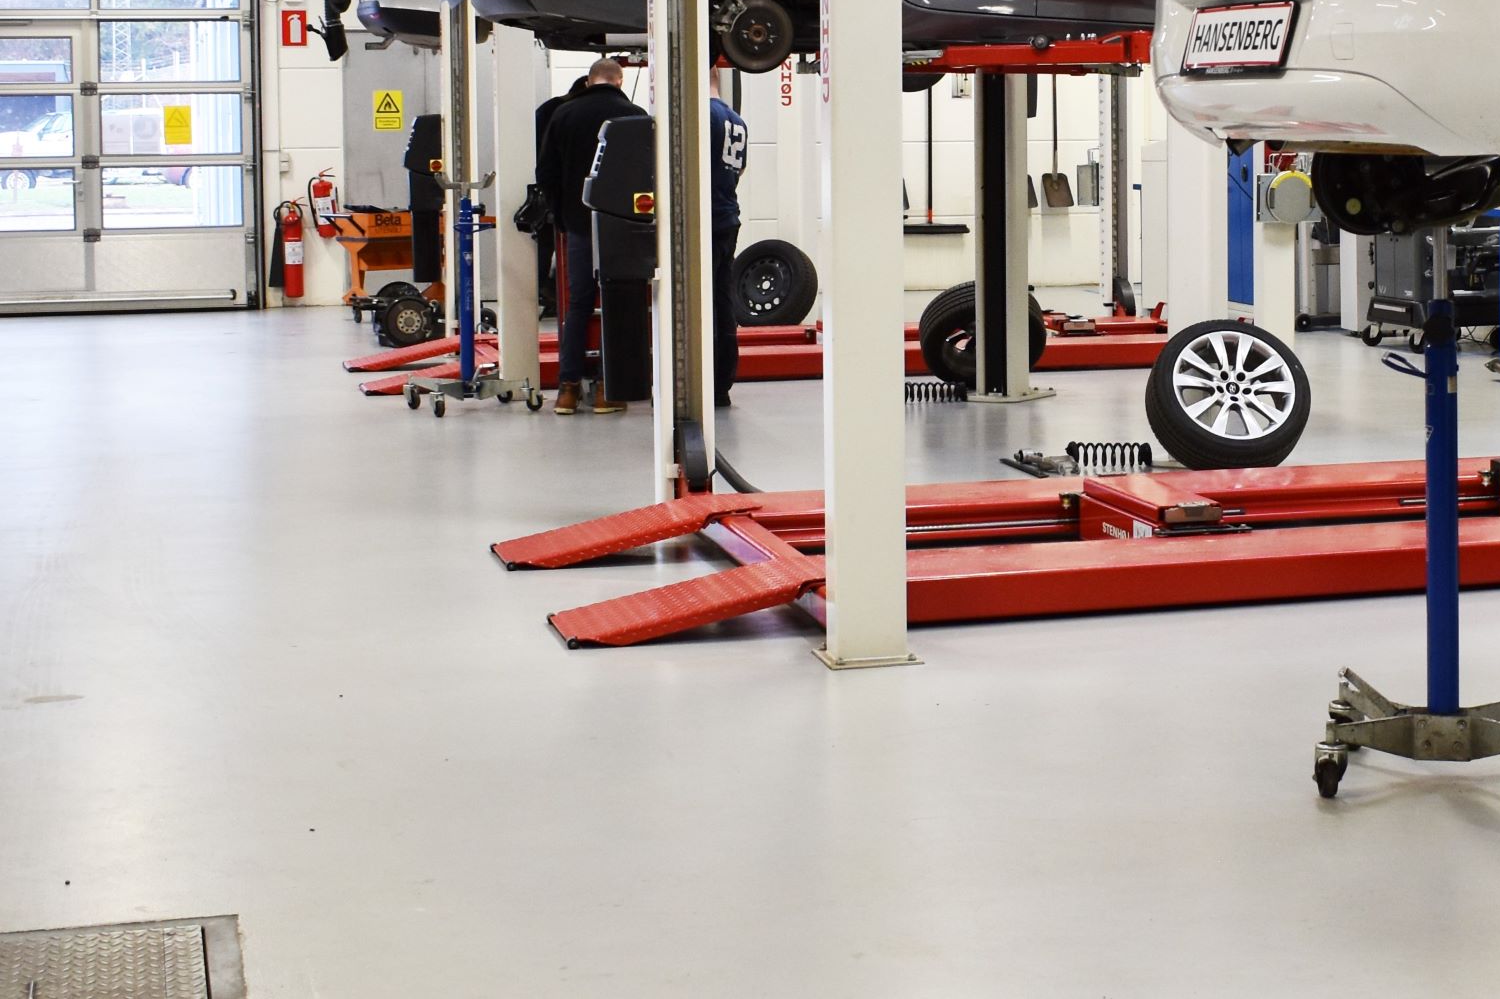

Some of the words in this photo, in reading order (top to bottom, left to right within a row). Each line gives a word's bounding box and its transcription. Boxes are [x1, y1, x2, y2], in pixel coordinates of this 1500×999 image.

[1192, 18, 1283, 54] HANSENBERG
[781, 56, 792, 106] NHØJ
[375, 214, 401, 226] Beta
